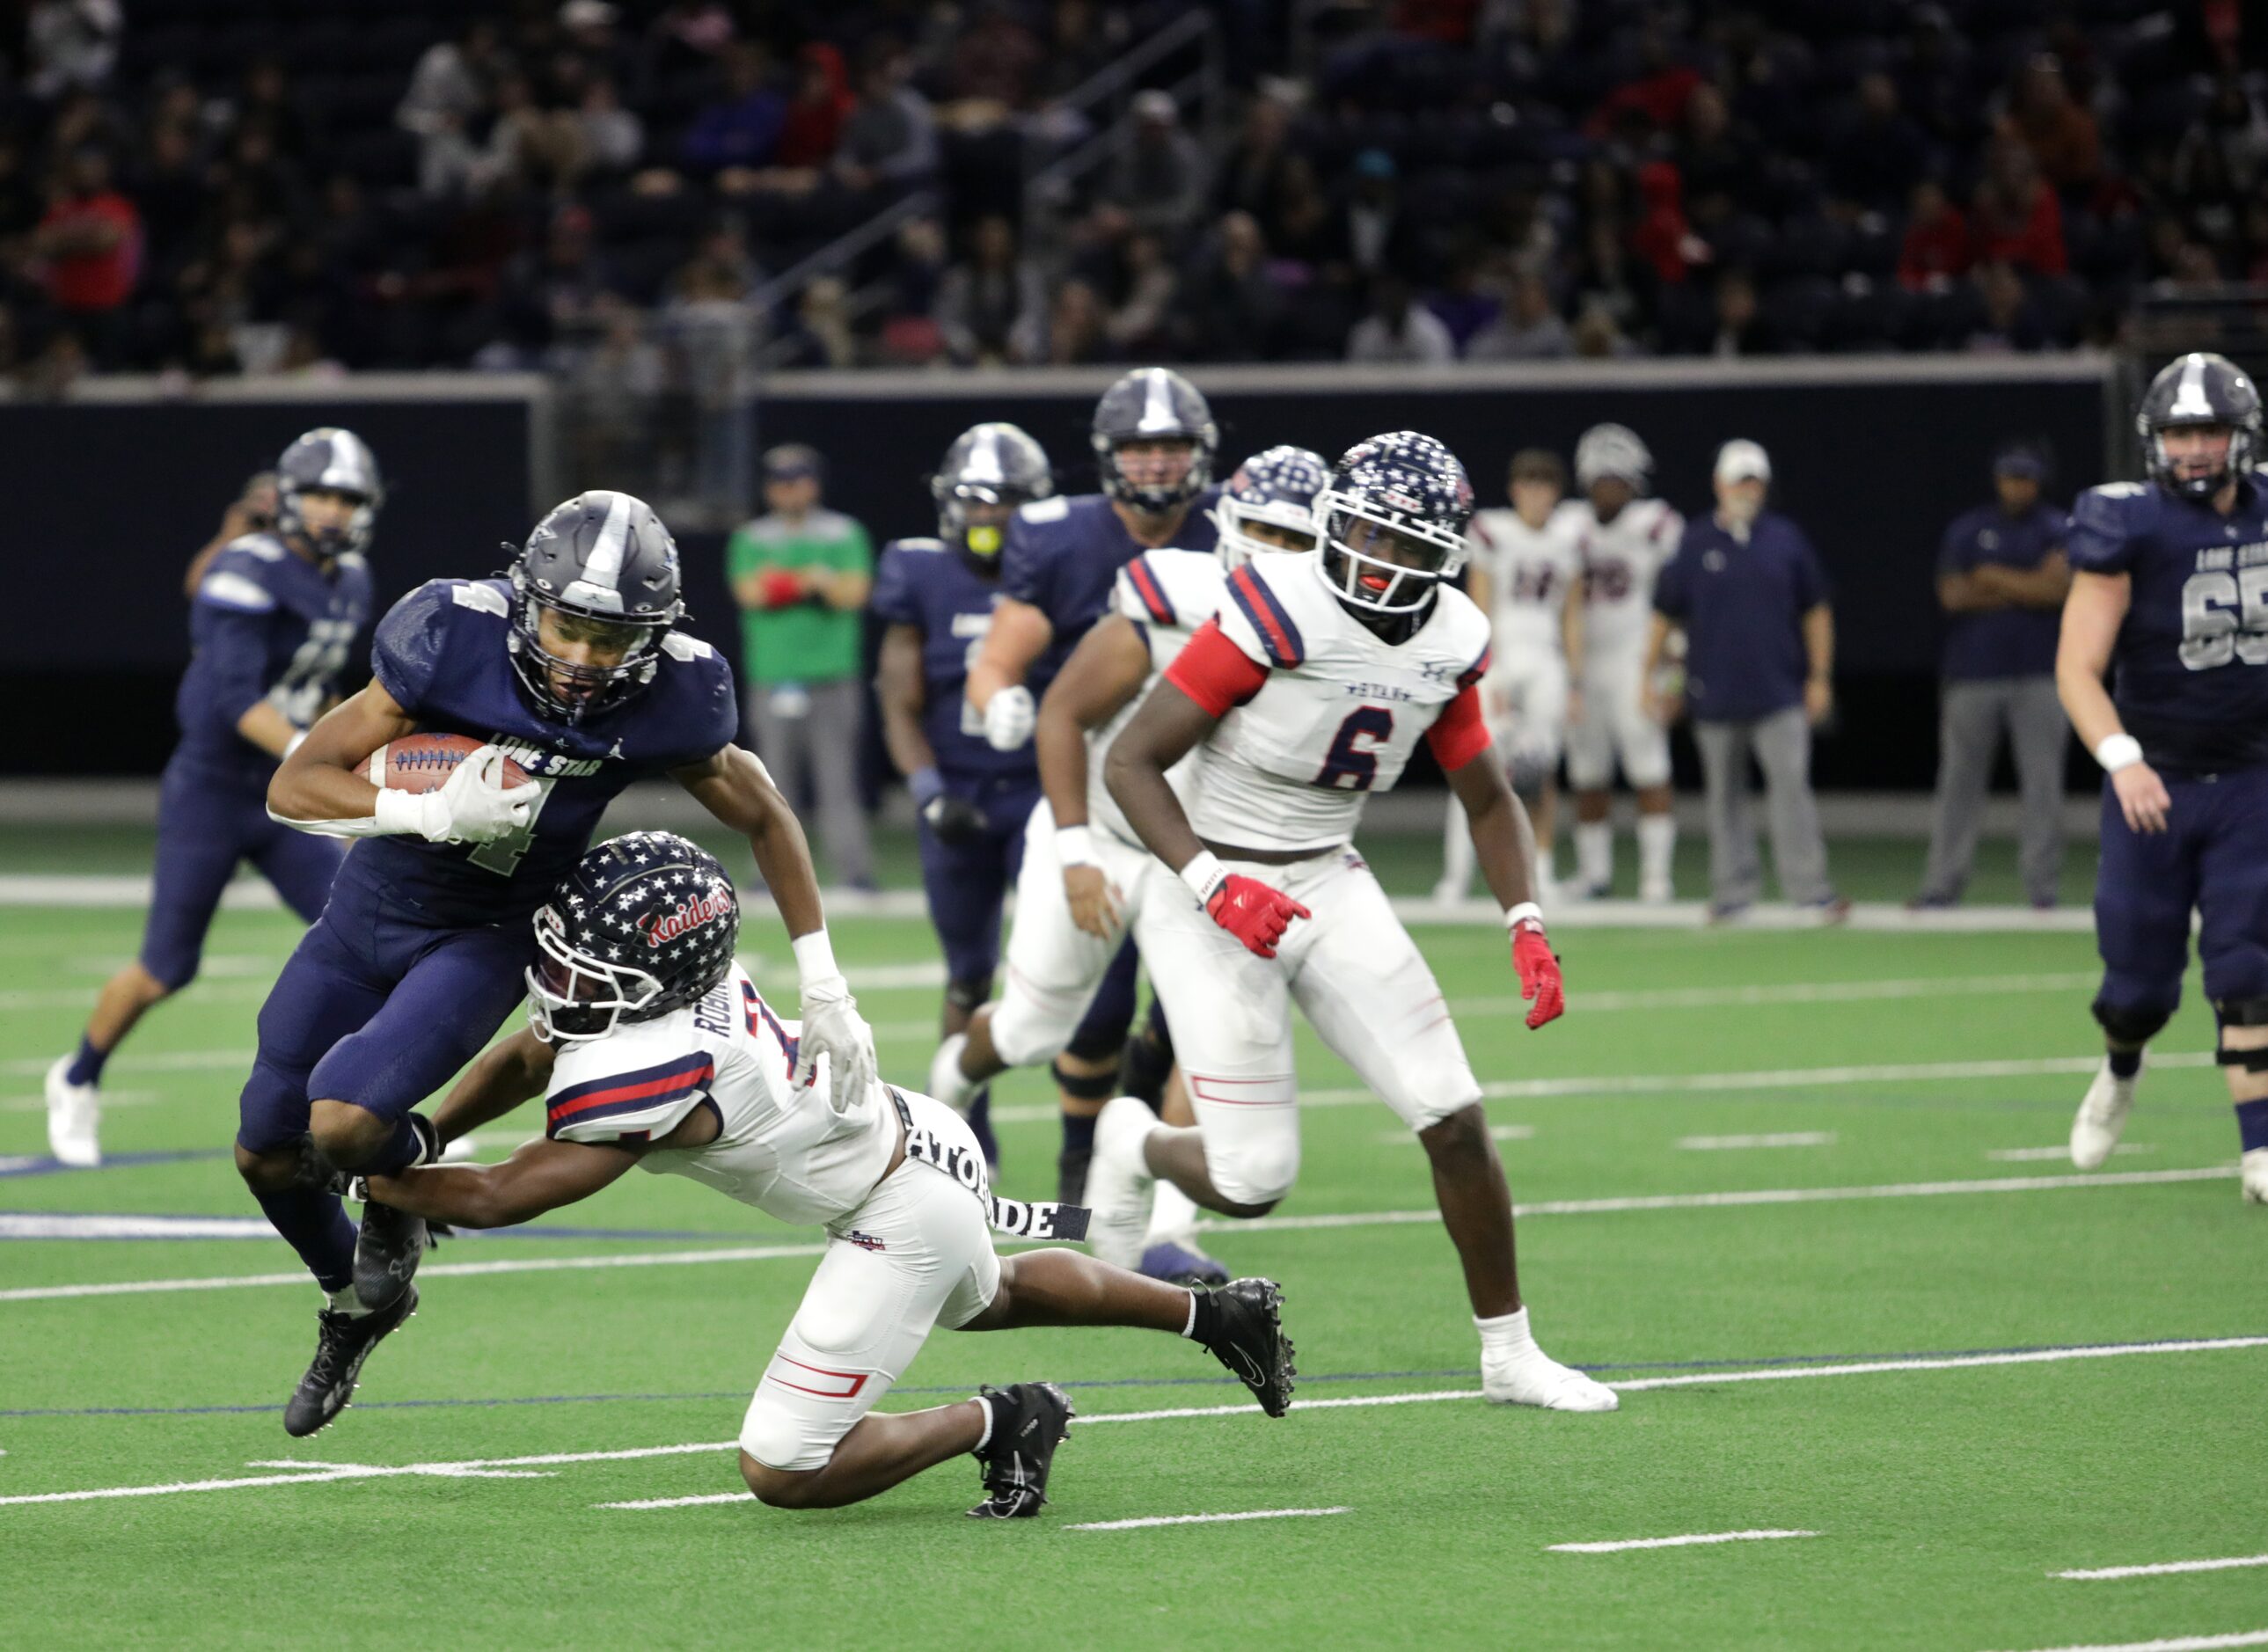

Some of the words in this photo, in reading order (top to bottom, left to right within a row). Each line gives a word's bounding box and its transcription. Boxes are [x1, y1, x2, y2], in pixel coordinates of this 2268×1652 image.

[2237, 540, 2268, 567] STA
[451, 581, 509, 618] 4
[544, 755, 604, 777] STAR
[1309, 705, 1394, 791] 6
[637, 888, 732, 948] Raiders
